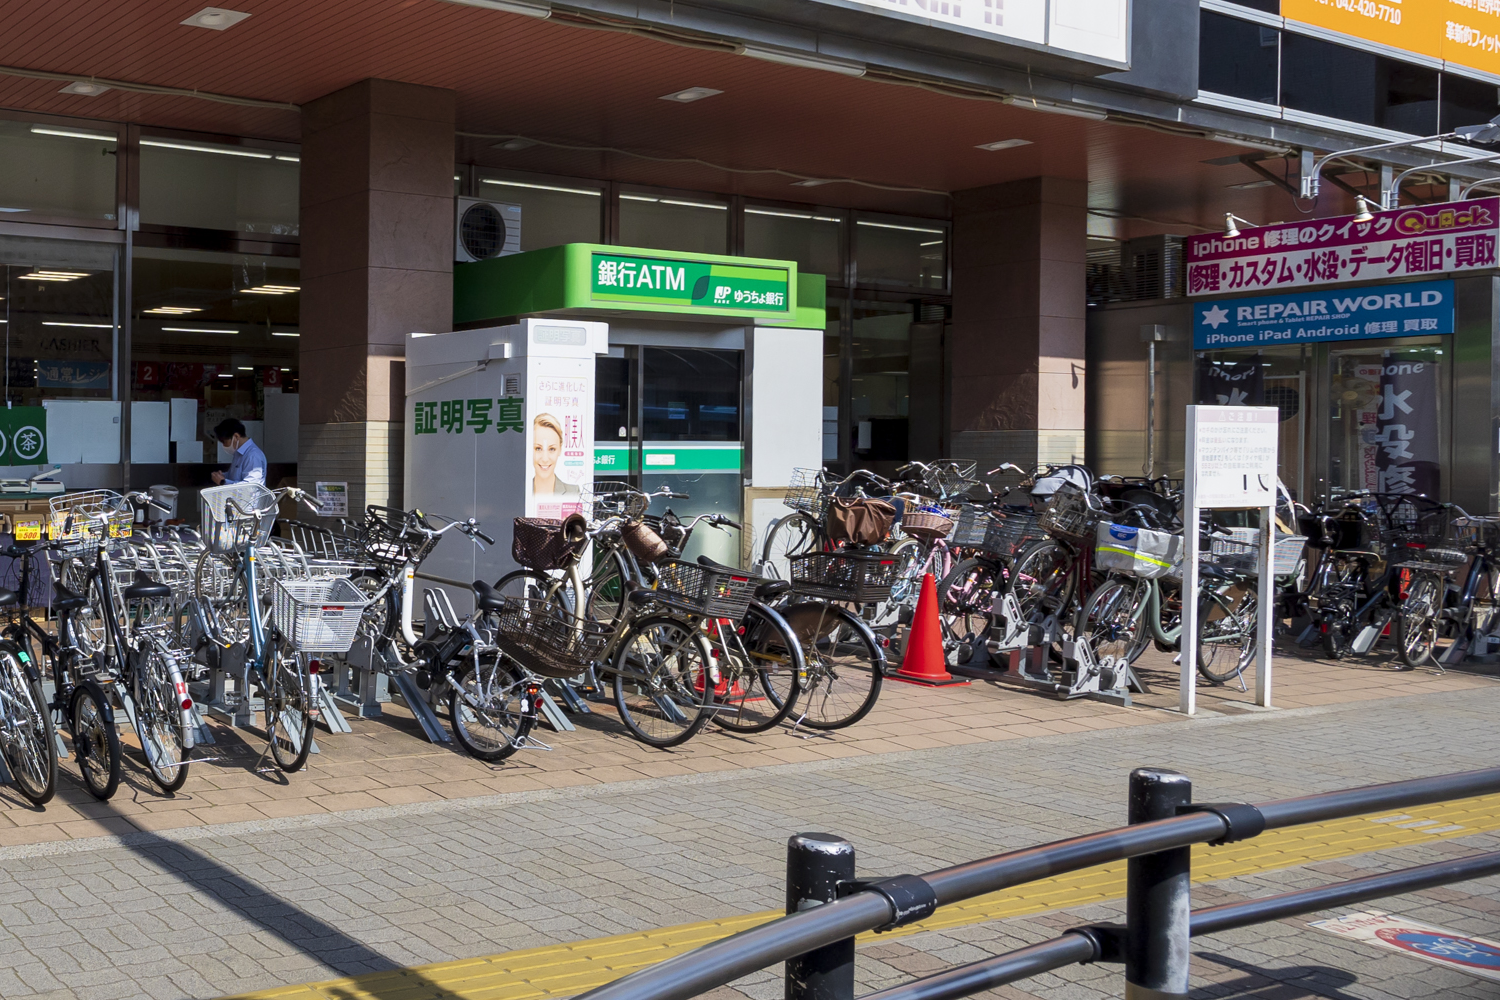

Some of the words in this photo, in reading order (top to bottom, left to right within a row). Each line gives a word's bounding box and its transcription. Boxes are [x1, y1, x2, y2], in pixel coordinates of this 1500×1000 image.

[1193, 235, 1259, 257] iphone
[1264, 217, 1392, 248] 修理のクイック
[598, 260, 685, 291] 銀行ATM
[734, 290, 784, 306] ゆうちょ銀行
[1237, 301, 1327, 320] REPAIR
[1332, 291, 1442, 312] WORLD
[1206, 332, 1254, 344] iPhone
[1259, 329, 1292, 341] iPad
[1296, 324, 1359, 338] Android
[1364, 321, 1398, 335] 修理
[1403, 318, 1438, 332] 買取
[1254, 319, 1277, 327] phone
[40, 338, 100, 352] CASHIER
[46, 366, 102, 382] 通常レジ
[144, 366, 153, 381] 2
[269, 370, 277, 383] 3
[538, 381, 585, 392] さらに進化した
[545, 396, 579, 407] 証明写真
[414, 396, 525, 435] 証明写真
[20, 432, 38, 451] 茶
